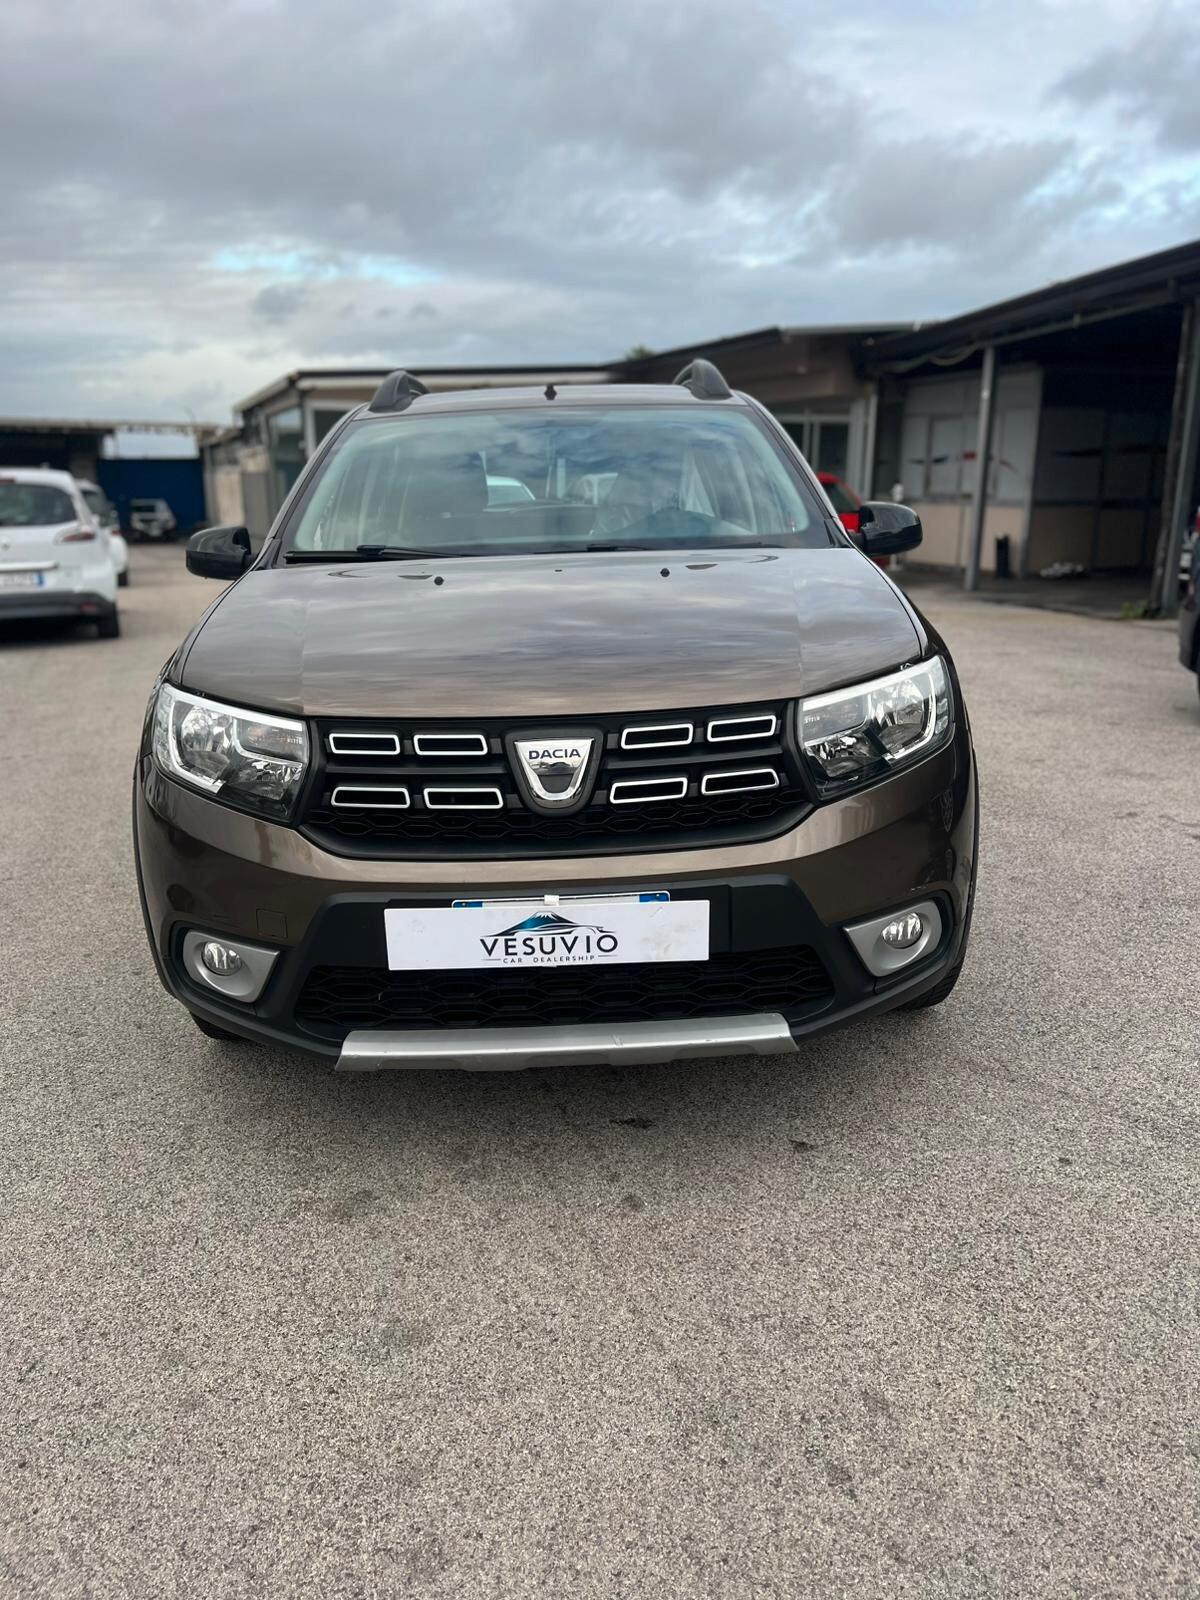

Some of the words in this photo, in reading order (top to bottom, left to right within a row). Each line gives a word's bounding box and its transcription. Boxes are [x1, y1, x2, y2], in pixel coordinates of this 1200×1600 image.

[528, 748, 581, 760] DACIA
[480, 934, 618, 957] VESUVIO
[533, 955, 595, 964] DEALERSHIP
